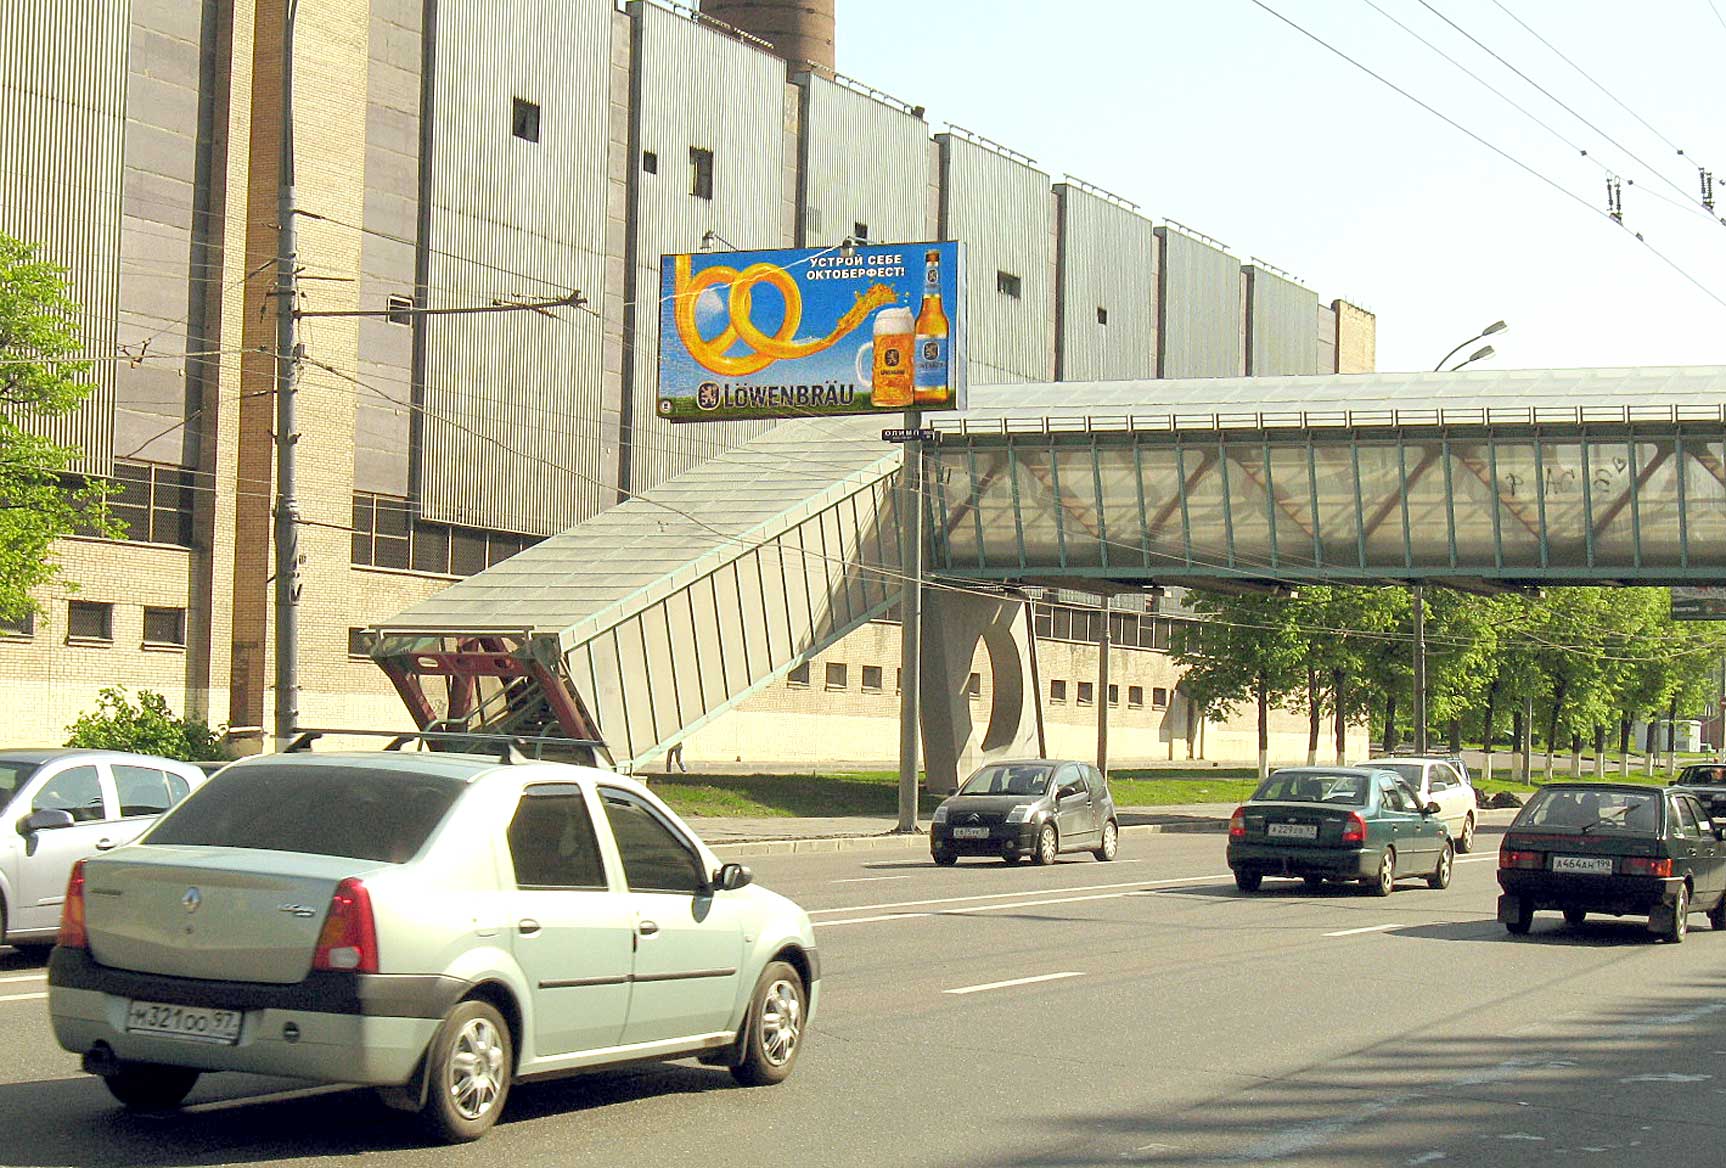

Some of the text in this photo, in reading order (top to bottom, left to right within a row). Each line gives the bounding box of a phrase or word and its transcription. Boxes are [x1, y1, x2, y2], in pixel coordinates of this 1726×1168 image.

[810, 253, 902, 267] УСТРОЙ СЕБЕ
[806, 266, 905, 280] ОКТОБЕРФЕСТ!
[723, 380, 855, 408] LÖWENBRÄU
